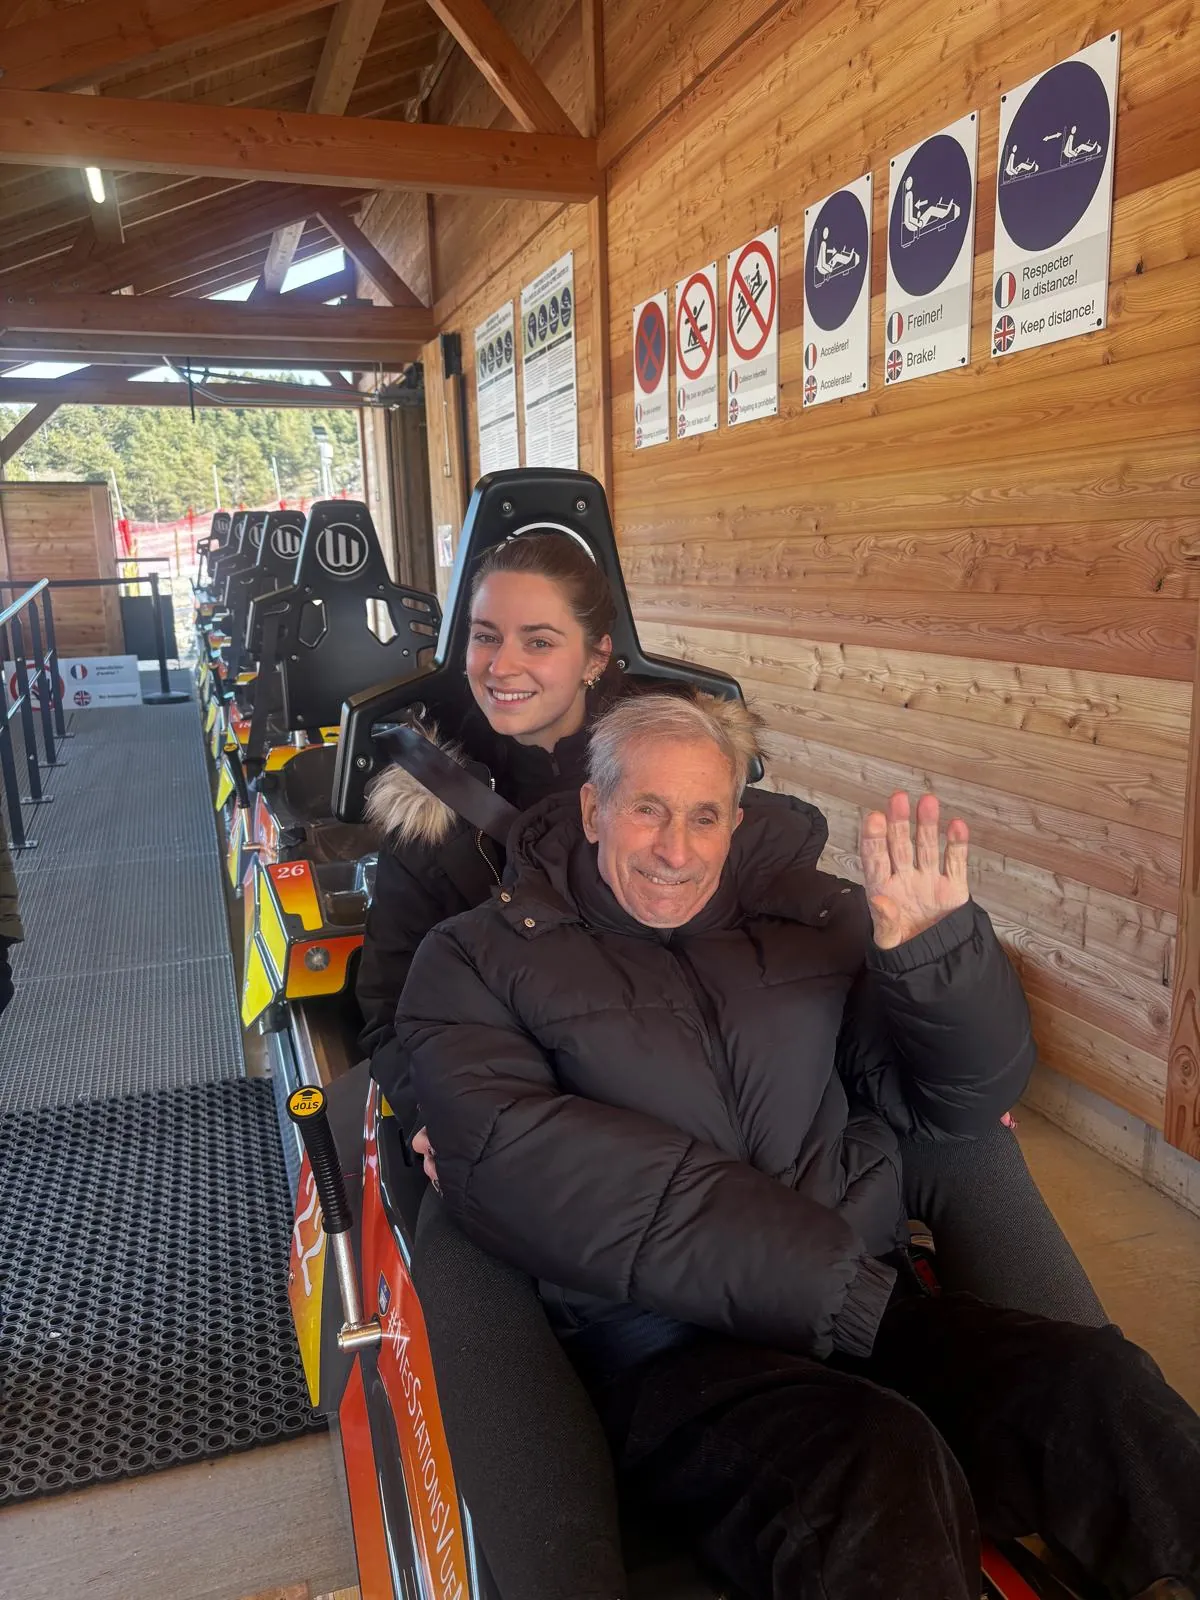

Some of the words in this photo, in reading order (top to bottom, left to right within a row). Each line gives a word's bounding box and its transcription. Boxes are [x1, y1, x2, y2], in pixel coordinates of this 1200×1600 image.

[1022, 253, 1073, 282] Respecter
[1021, 287, 1030, 301] la
[1032, 269, 1078, 298] distance!
[907, 304, 943, 331] Freiner!
[1020, 319, 1046, 335] Keep
[1048, 300, 1095, 327] distance!
[906, 345, 936, 368] Brake!
[820, 372, 852, 391] Accelerate!
[277, 864, 304, 880] 26
[292, 1101, 320, 1111] STOP
